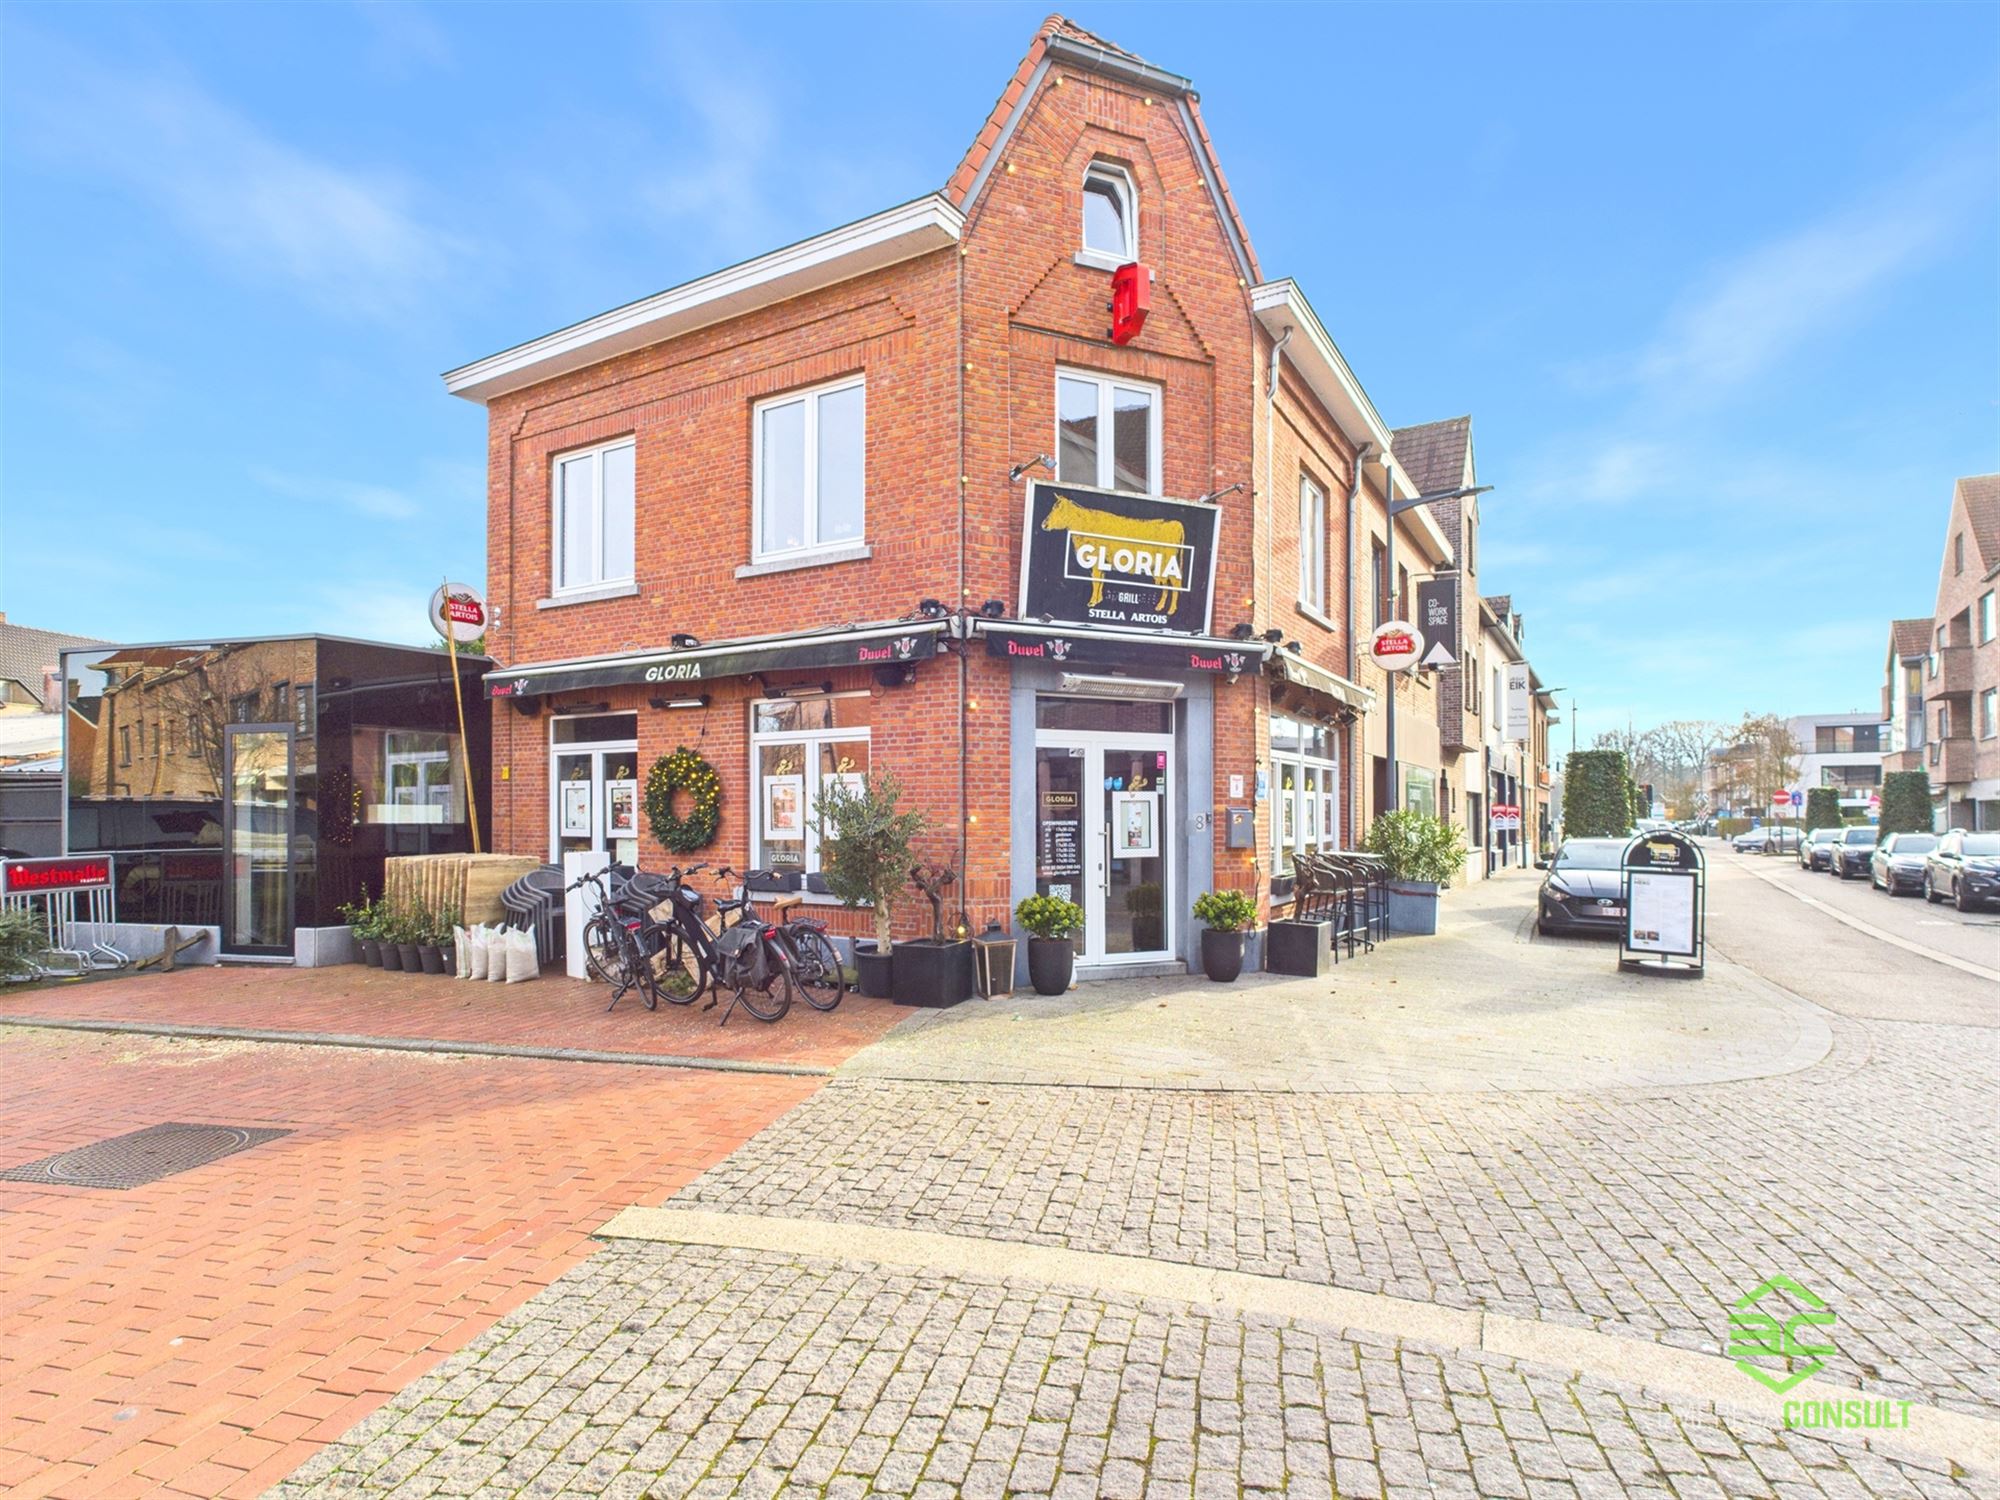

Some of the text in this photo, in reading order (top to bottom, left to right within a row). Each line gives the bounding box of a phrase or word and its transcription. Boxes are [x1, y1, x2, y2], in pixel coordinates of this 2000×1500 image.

[1076, 543, 1182, 580] GLORIA
[1118, 592, 1139, 604] GRILL
[450, 603, 478, 614] STELLA
[1428, 607, 1448, 616] WORK
[450, 611, 478, 621] ARTOIS
[1088, 608, 1168, 624] STELLA ARTOIS
[1428, 616, 1448, 626] SPACE
[1381, 638, 1408, 646] STELLA
[858, 645, 892, 660] Duvel
[1008, 640, 1044, 657] Duvel
[1191, 654, 1222, 669] Duvel
[646, 663, 701, 681] GLORIA
[1509, 681, 1526, 690] EIK
[1045, 796, 1074, 804] GLORIA
[1196, 815, 1204, 830] 8
[771, 854, 799, 863] GLORIA
[8, 864, 107, 887] Westmalle
